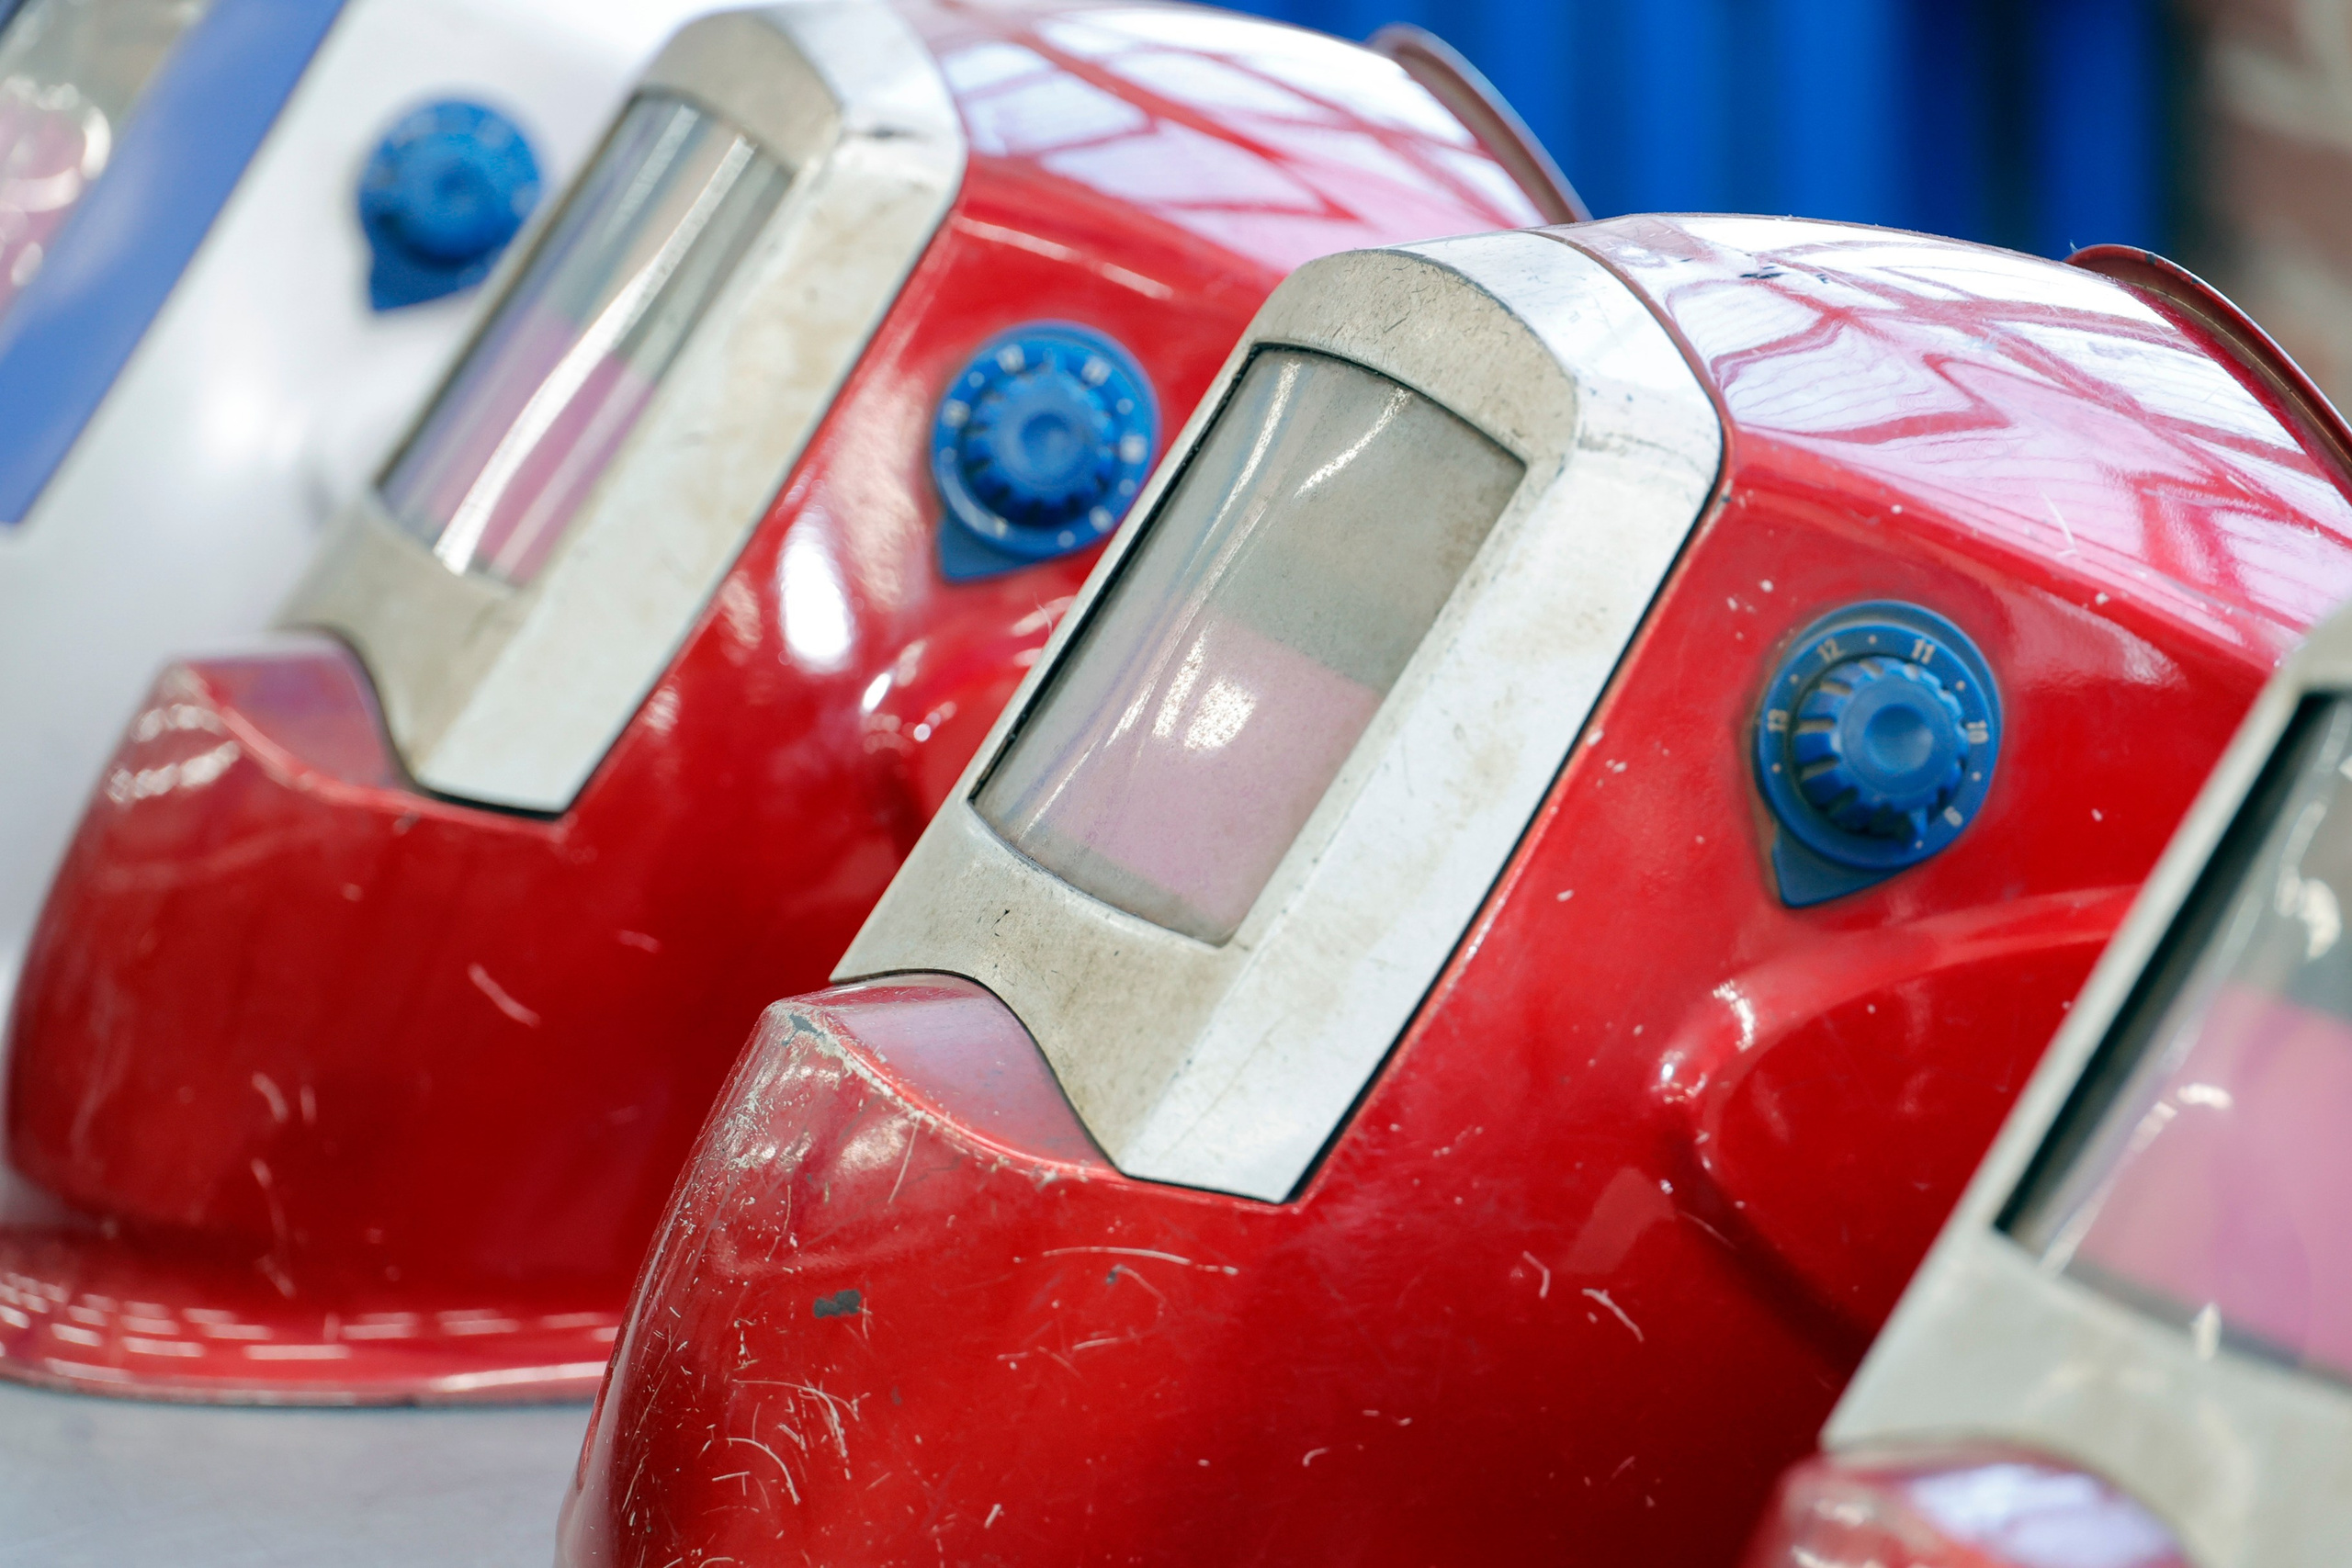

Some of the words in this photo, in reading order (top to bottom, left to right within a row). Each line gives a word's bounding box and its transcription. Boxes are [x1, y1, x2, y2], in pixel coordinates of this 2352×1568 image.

[1816, 637, 1846, 662] 12
[1911, 637, 1936, 664] 11
[1966, 720, 1988, 743] 10
